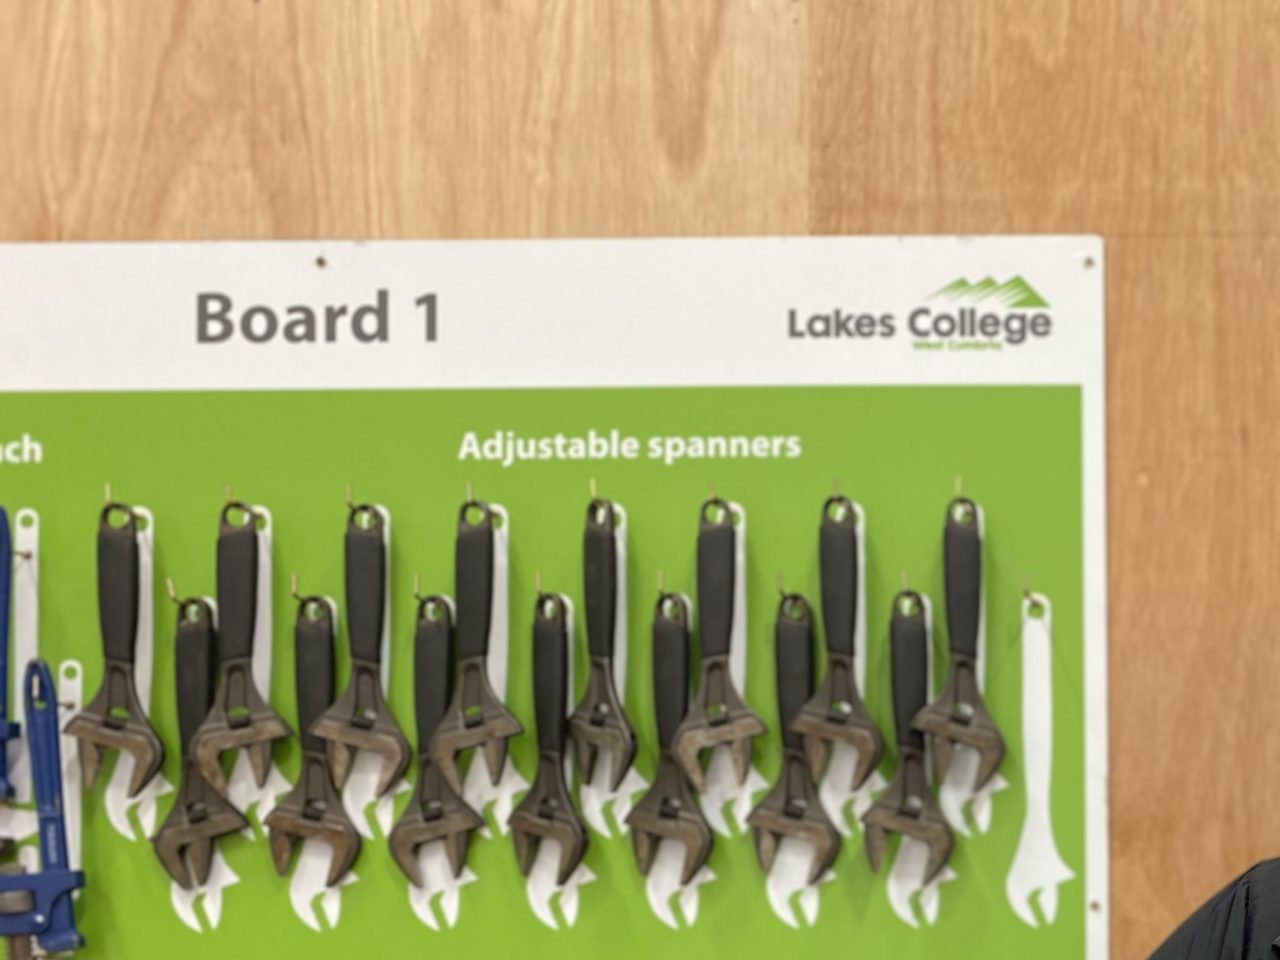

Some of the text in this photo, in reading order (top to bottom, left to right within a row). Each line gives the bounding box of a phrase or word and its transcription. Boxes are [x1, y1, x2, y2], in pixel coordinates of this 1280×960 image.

[196, 289, 438, 344] Board 1
[788, 307, 1052, 345] Lakes College
[458, 430, 802, 467] Adjustable spanners
